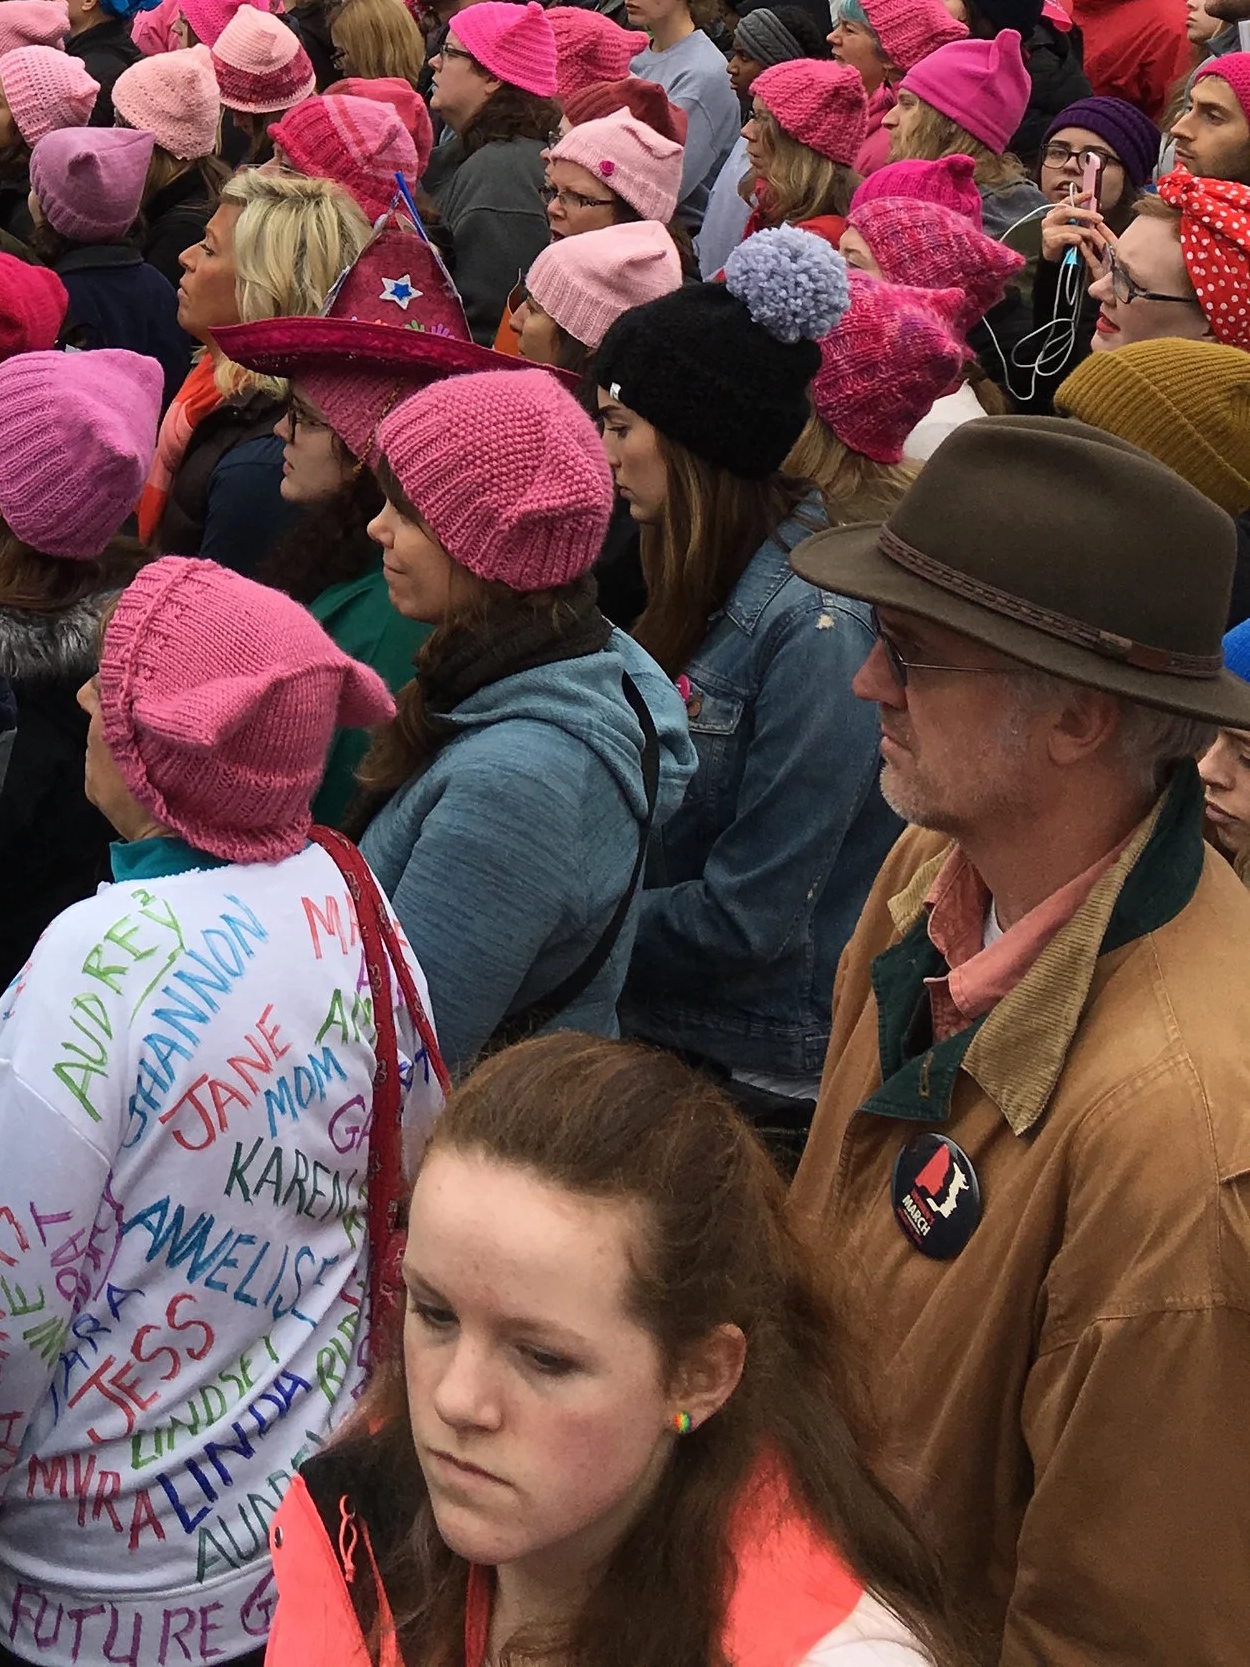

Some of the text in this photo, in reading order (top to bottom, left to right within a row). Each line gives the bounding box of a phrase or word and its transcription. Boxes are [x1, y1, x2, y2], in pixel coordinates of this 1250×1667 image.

[121, 894, 269, 1148] SHANNON
[159, 1003, 293, 1151] JANE
[264, 1047, 348, 1139] MOM
[224, 1136, 358, 1222] KAREN
[902, 1194, 931, 1237] MARCH
[67, 1292, 215, 1446] JESS
[156, 1369, 313, 1535] LINDA
[26, 1453, 166, 1552] MYRA
[8, 1582, 227, 1667] FUTURE
